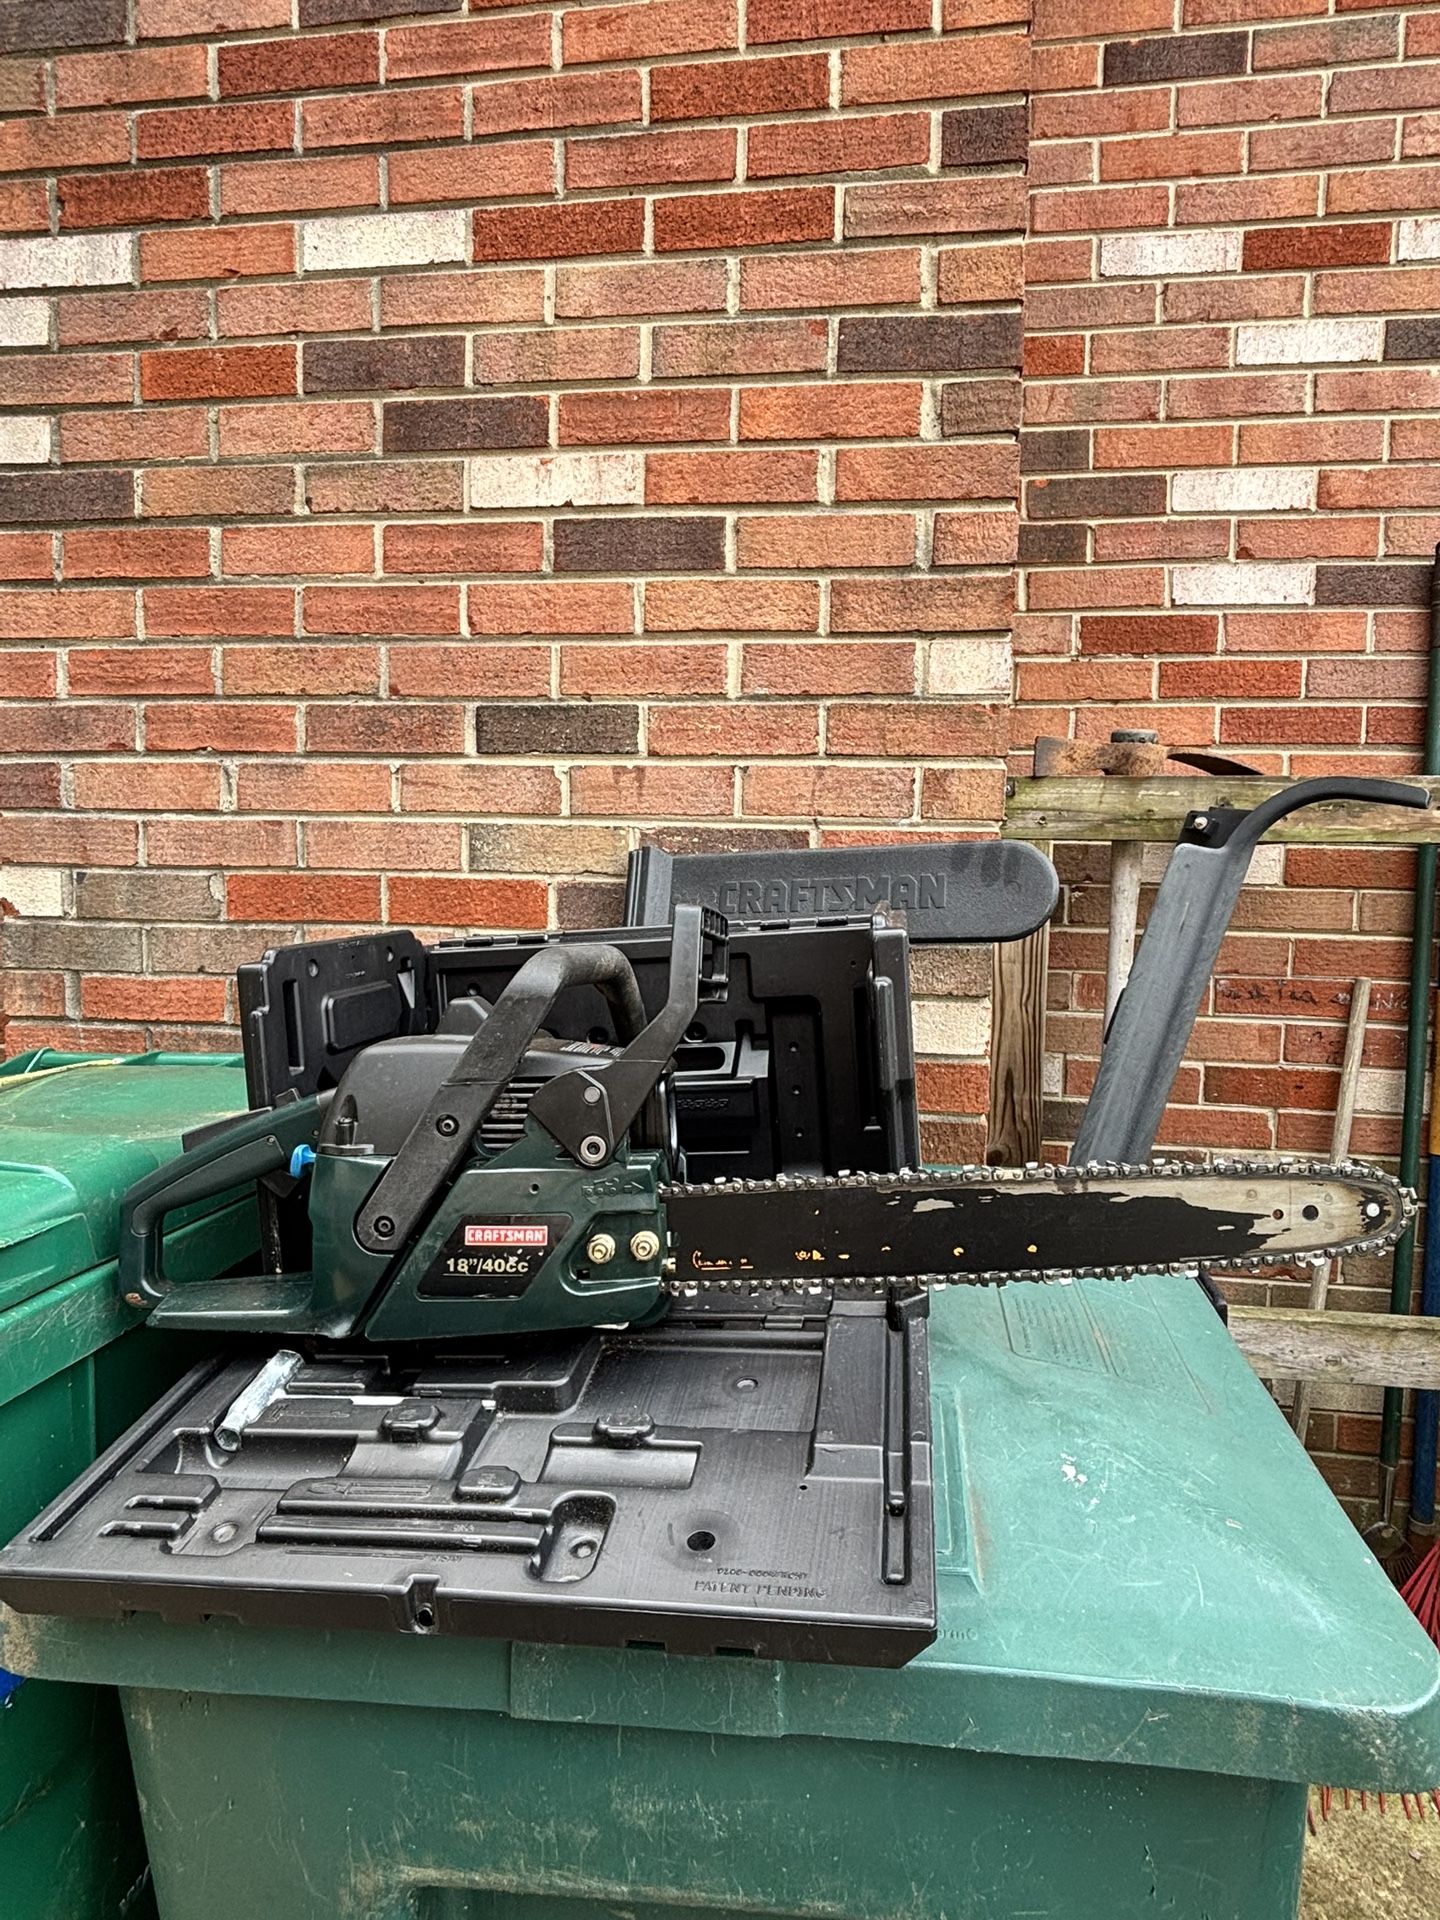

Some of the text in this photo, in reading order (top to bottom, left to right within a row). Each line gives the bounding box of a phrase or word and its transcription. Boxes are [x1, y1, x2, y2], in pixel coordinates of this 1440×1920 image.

[718, 872, 948, 915] CRAFTSMAN
[468, 1228, 546, 1242] CRAFTSMAN
[694, 1580, 827, 1599] PATENT PENDING
